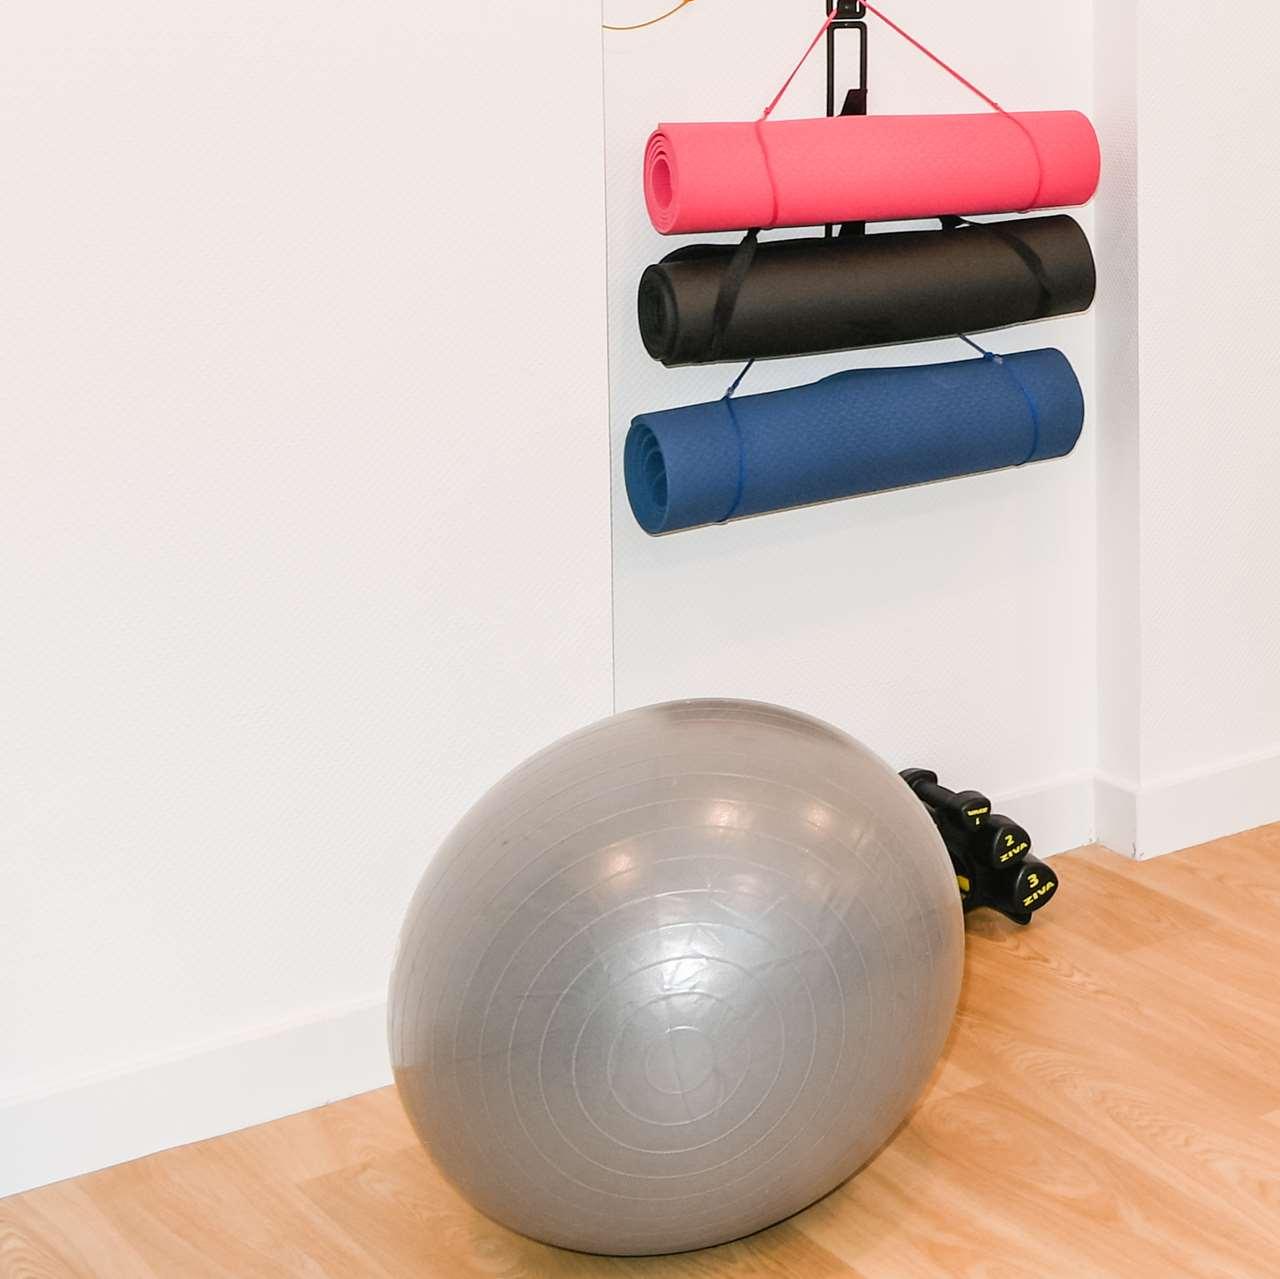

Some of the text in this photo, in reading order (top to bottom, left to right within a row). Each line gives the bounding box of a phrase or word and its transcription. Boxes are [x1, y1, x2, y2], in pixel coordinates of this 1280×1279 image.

[1004, 834, 1014, 846] 2
[999, 841, 1028, 863] ZIVA
[1027, 873, 1039, 888] 3
[1023, 880, 1055, 907] ZIVA
